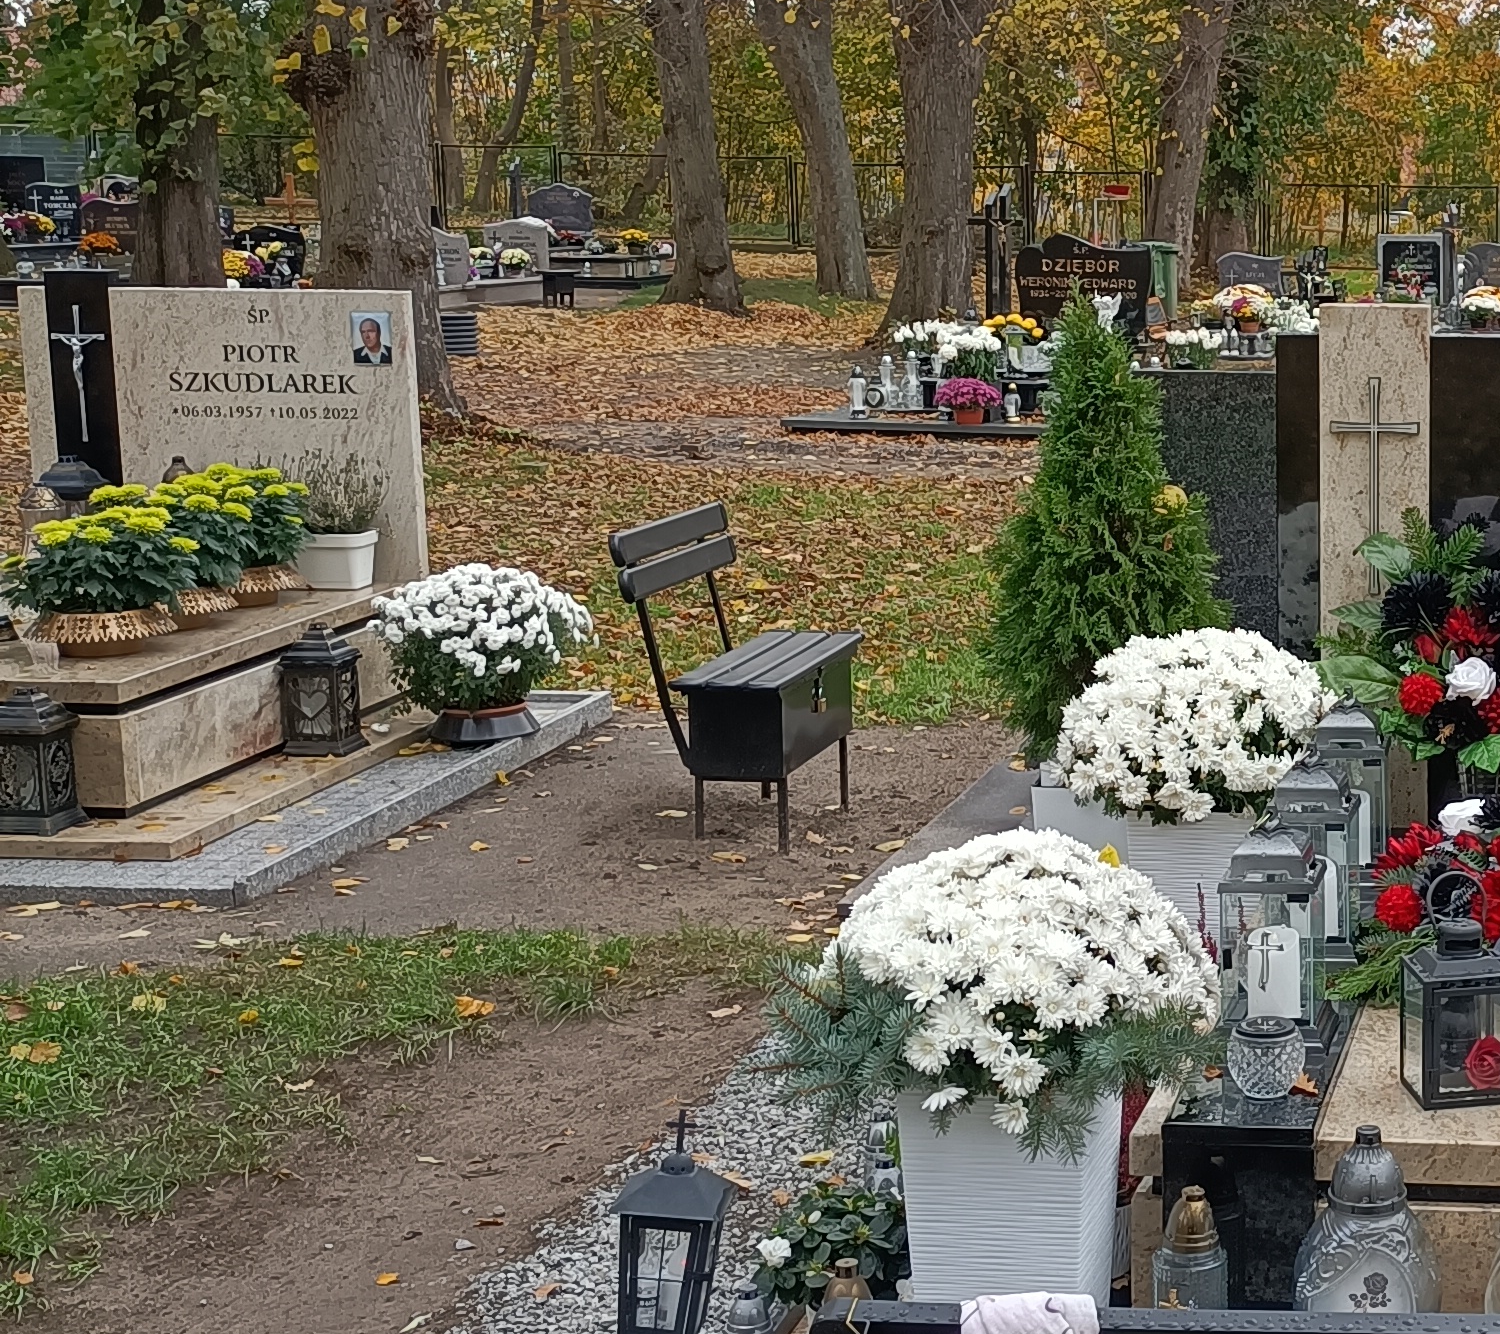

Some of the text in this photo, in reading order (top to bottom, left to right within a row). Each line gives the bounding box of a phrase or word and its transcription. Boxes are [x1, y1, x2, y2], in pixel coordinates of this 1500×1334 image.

[1041, 255, 1120, 275] DZIĘBÓR
[1019, 275, 1137, 290] WERONIK EDWARD
[222, 343, 300, 364] PIOTR
[169, 371, 360, 395] SZKUDLAREK
